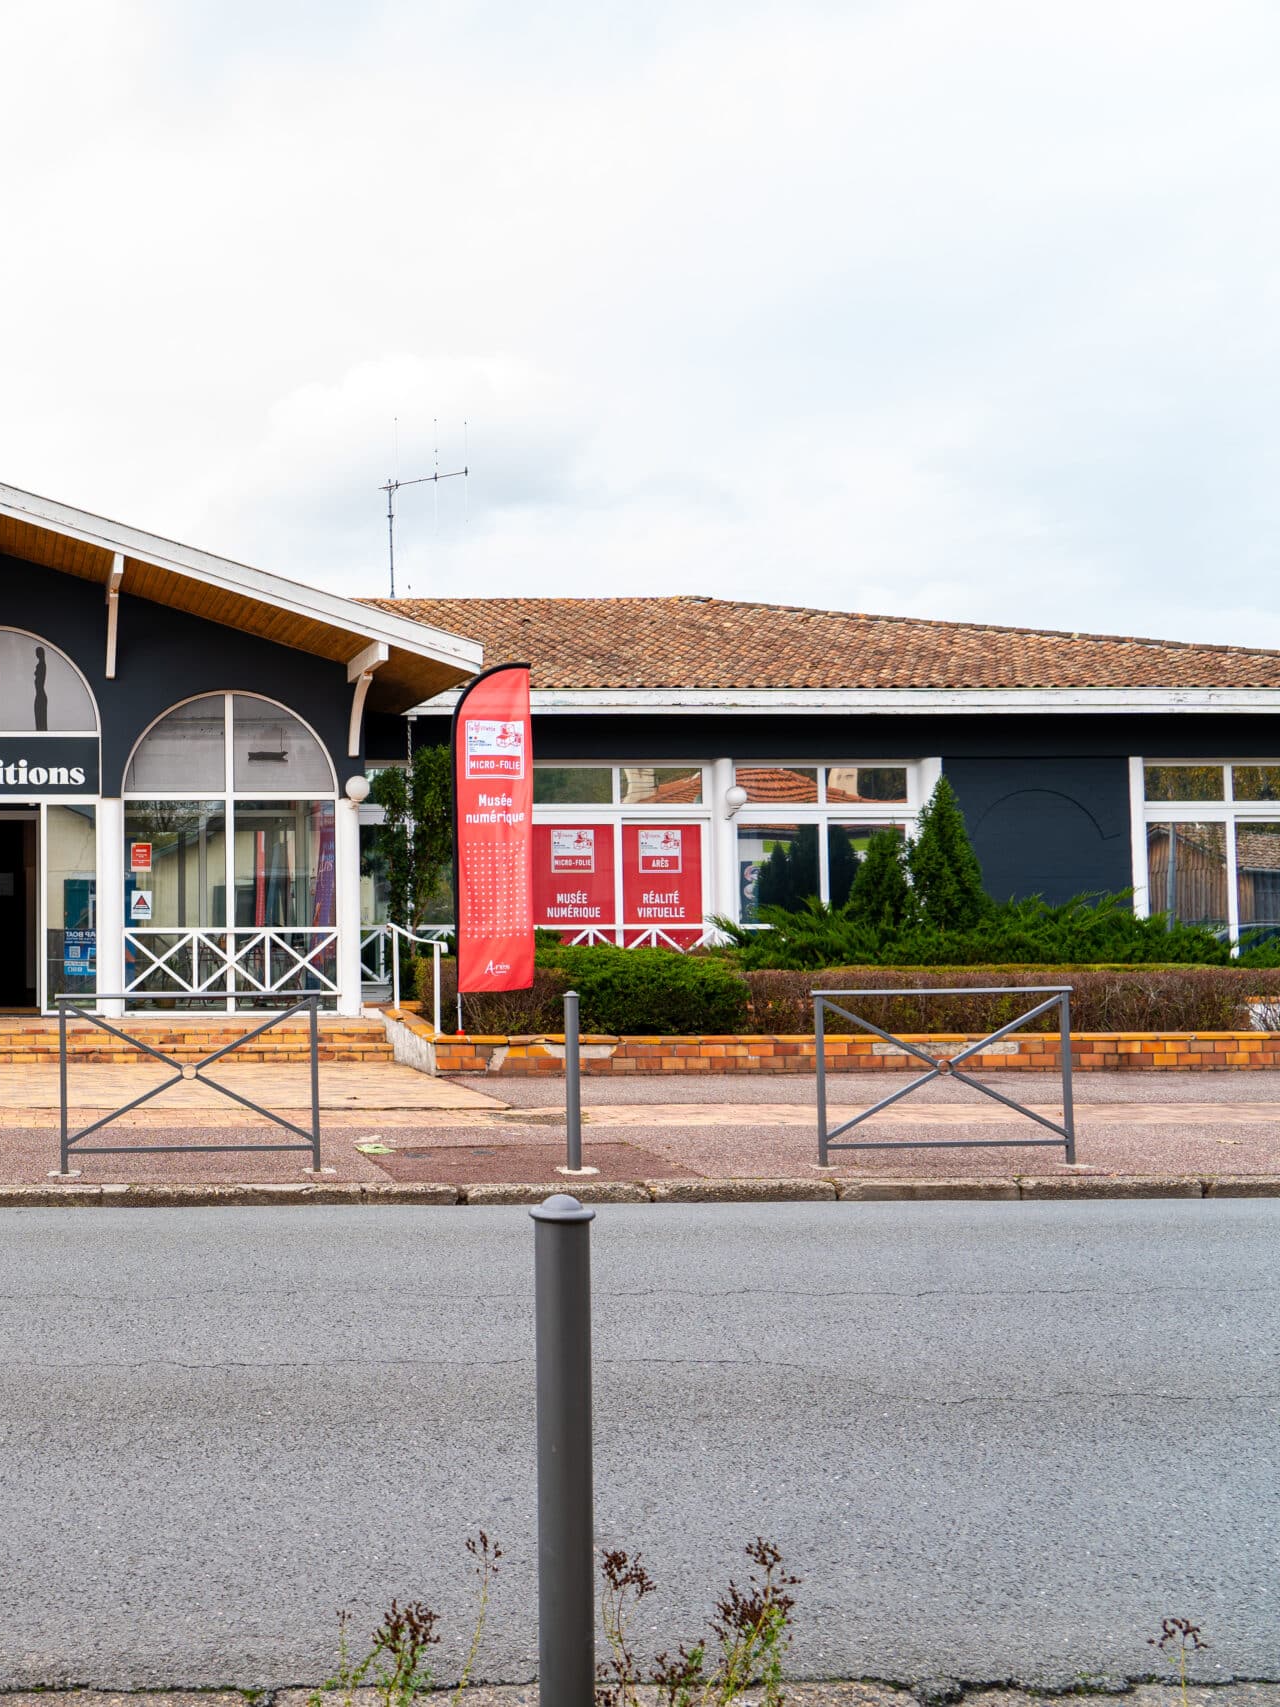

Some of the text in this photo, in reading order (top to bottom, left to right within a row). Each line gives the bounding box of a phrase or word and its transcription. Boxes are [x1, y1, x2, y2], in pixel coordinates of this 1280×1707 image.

[470, 760, 521, 770] MICRO-FOLIE
[478, 793, 513, 807] Musée
[465, 810, 525, 826] numérique
[651, 857, 669, 868] ARÈS
[556, 890, 588, 904] MUSÉE
[642, 890, 680, 904] RÉALITÉ
[546, 904, 601, 919] NUMÉRIQUE
[637, 906, 685, 918] VIRTUELLE
